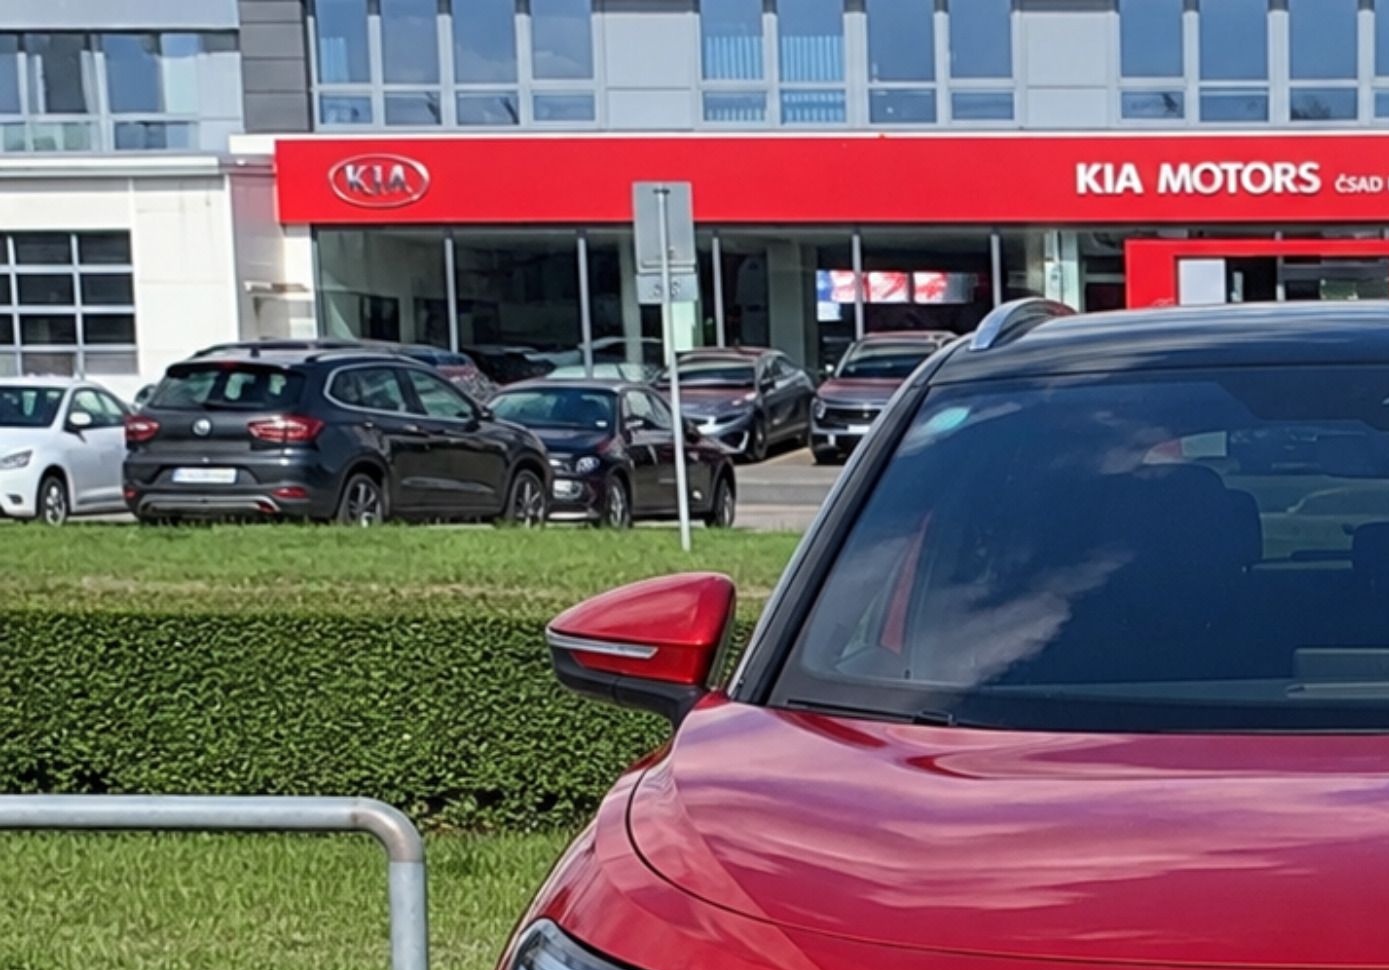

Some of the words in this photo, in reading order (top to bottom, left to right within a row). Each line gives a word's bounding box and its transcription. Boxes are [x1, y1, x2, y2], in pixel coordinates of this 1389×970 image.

[345, 164, 413, 194] KIA
[1076, 162, 1144, 194] KIA
[1157, 161, 1321, 194] MOTORS
